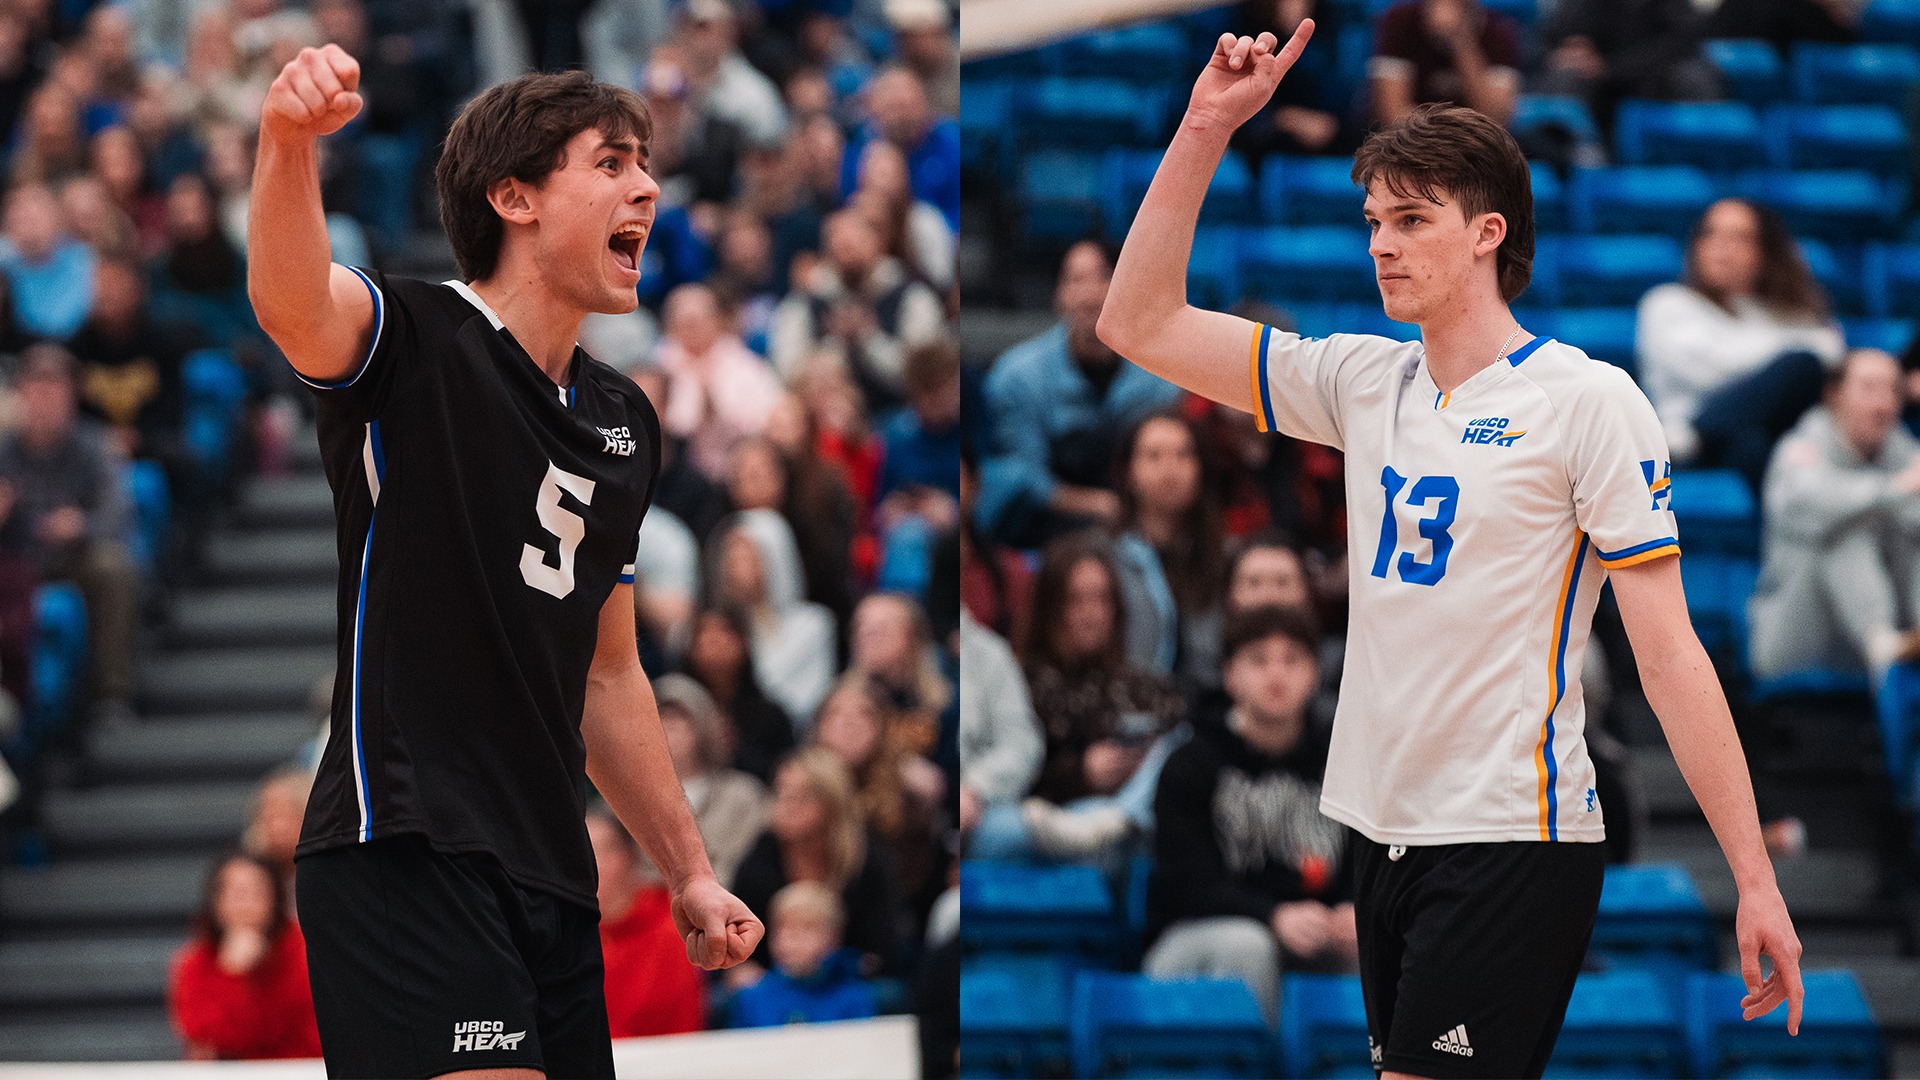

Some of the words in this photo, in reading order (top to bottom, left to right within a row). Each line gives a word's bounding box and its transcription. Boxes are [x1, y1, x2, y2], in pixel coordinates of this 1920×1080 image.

[1468, 417, 1510, 429] UBCO
[1461, 427, 1529, 447] HEAT
[519, 458, 596, 600] 5
[1371, 465, 1460, 587] 13
[454, 1020, 504, 1034] UBCO
[452, 1030, 527, 1053] HEAT
[1432, 1040, 1474, 1057] adidas
